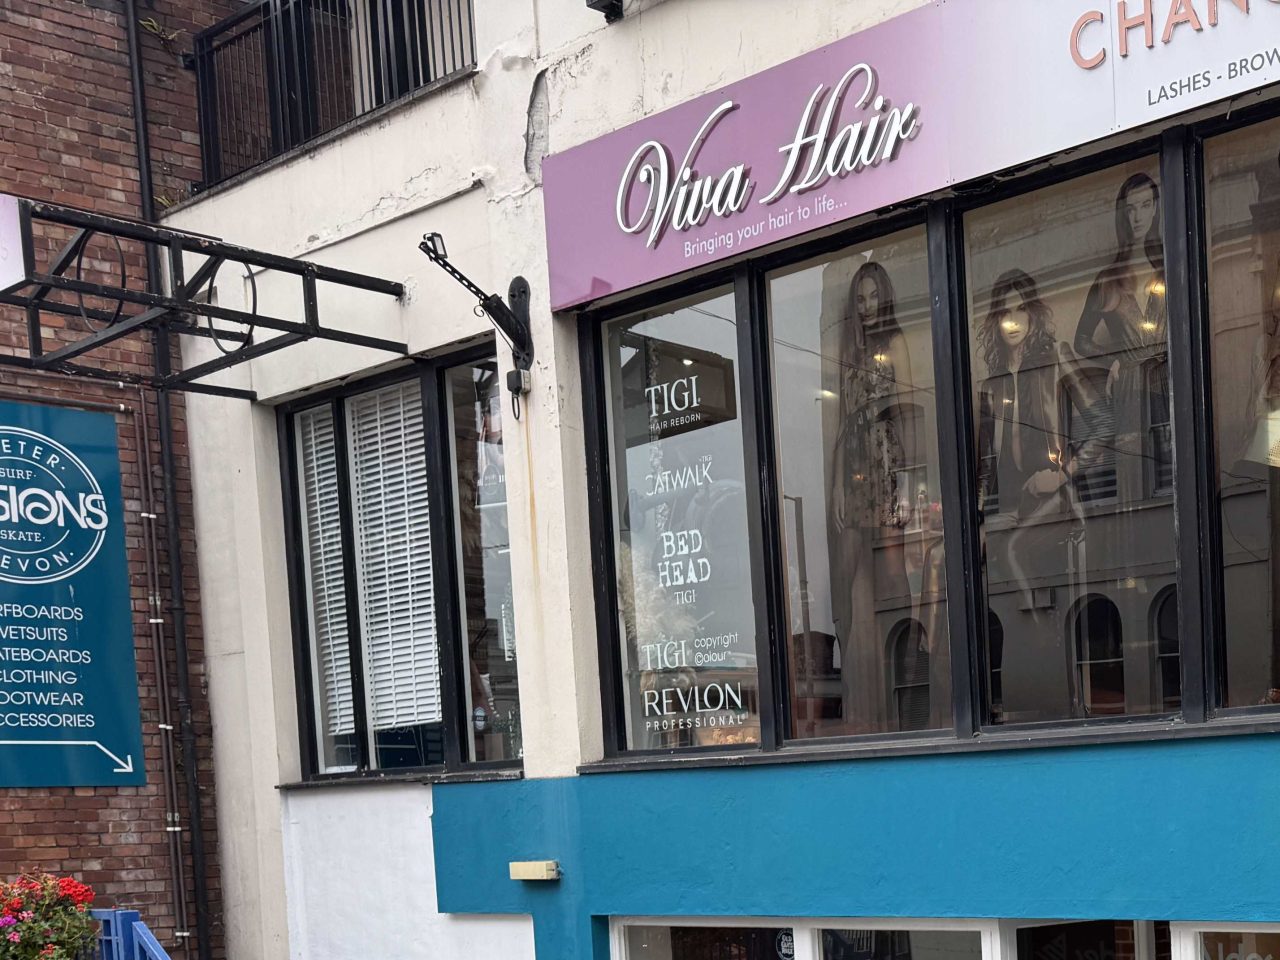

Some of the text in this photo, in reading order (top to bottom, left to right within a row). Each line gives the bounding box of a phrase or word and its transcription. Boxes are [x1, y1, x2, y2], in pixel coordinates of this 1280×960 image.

[1148, 70, 1211, 106] LASHES
[616, 63, 917, 248] Viva Hair
[684, 232, 734, 258] Bringing
[737, 221, 766, 244] your
[768, 207, 793, 231] hair
[798, 205, 811, 220] to
[645, 376, 701, 417] TIGI
[650, 412, 701, 432] HAIR REBORN
[645, 461, 713, 496] CATWALK
[0, 529, 42, 542] SKATE
[662, 529, 702, 559] BED
[658, 558, 711, 588] HEAD
[674, 589, 696, 606] TIGI
[641, 640, 688, 671] TIGI
[694, 632, 739, 650] copyright
[0, 669, 78, 685] LOTHING
[644, 682, 742, 716] REVLON
